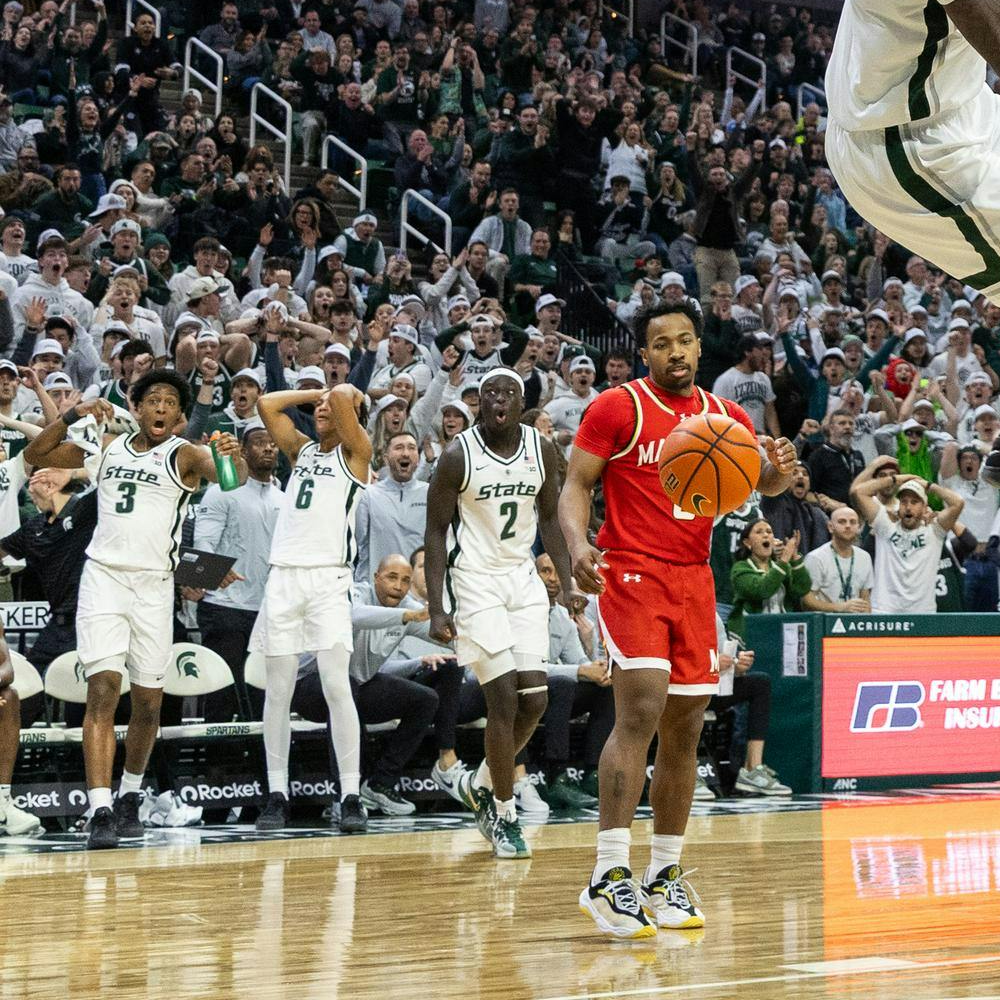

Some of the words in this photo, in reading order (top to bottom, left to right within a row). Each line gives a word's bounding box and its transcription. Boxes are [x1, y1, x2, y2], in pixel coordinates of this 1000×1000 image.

[104, 466, 160, 487] State
[115, 482, 137, 514] 3
[295, 480, 315, 509] 6
[475, 482, 537, 500] State
[499, 501, 519, 540] 2
[930, 680, 986, 702] FARM
[22, 732, 47, 742] TANS
[206, 725, 250, 736] SPARTANS
[198, 780, 262, 801] Rocket
[291, 780, 336, 796] Rock
[15, 790, 60, 808] cket
